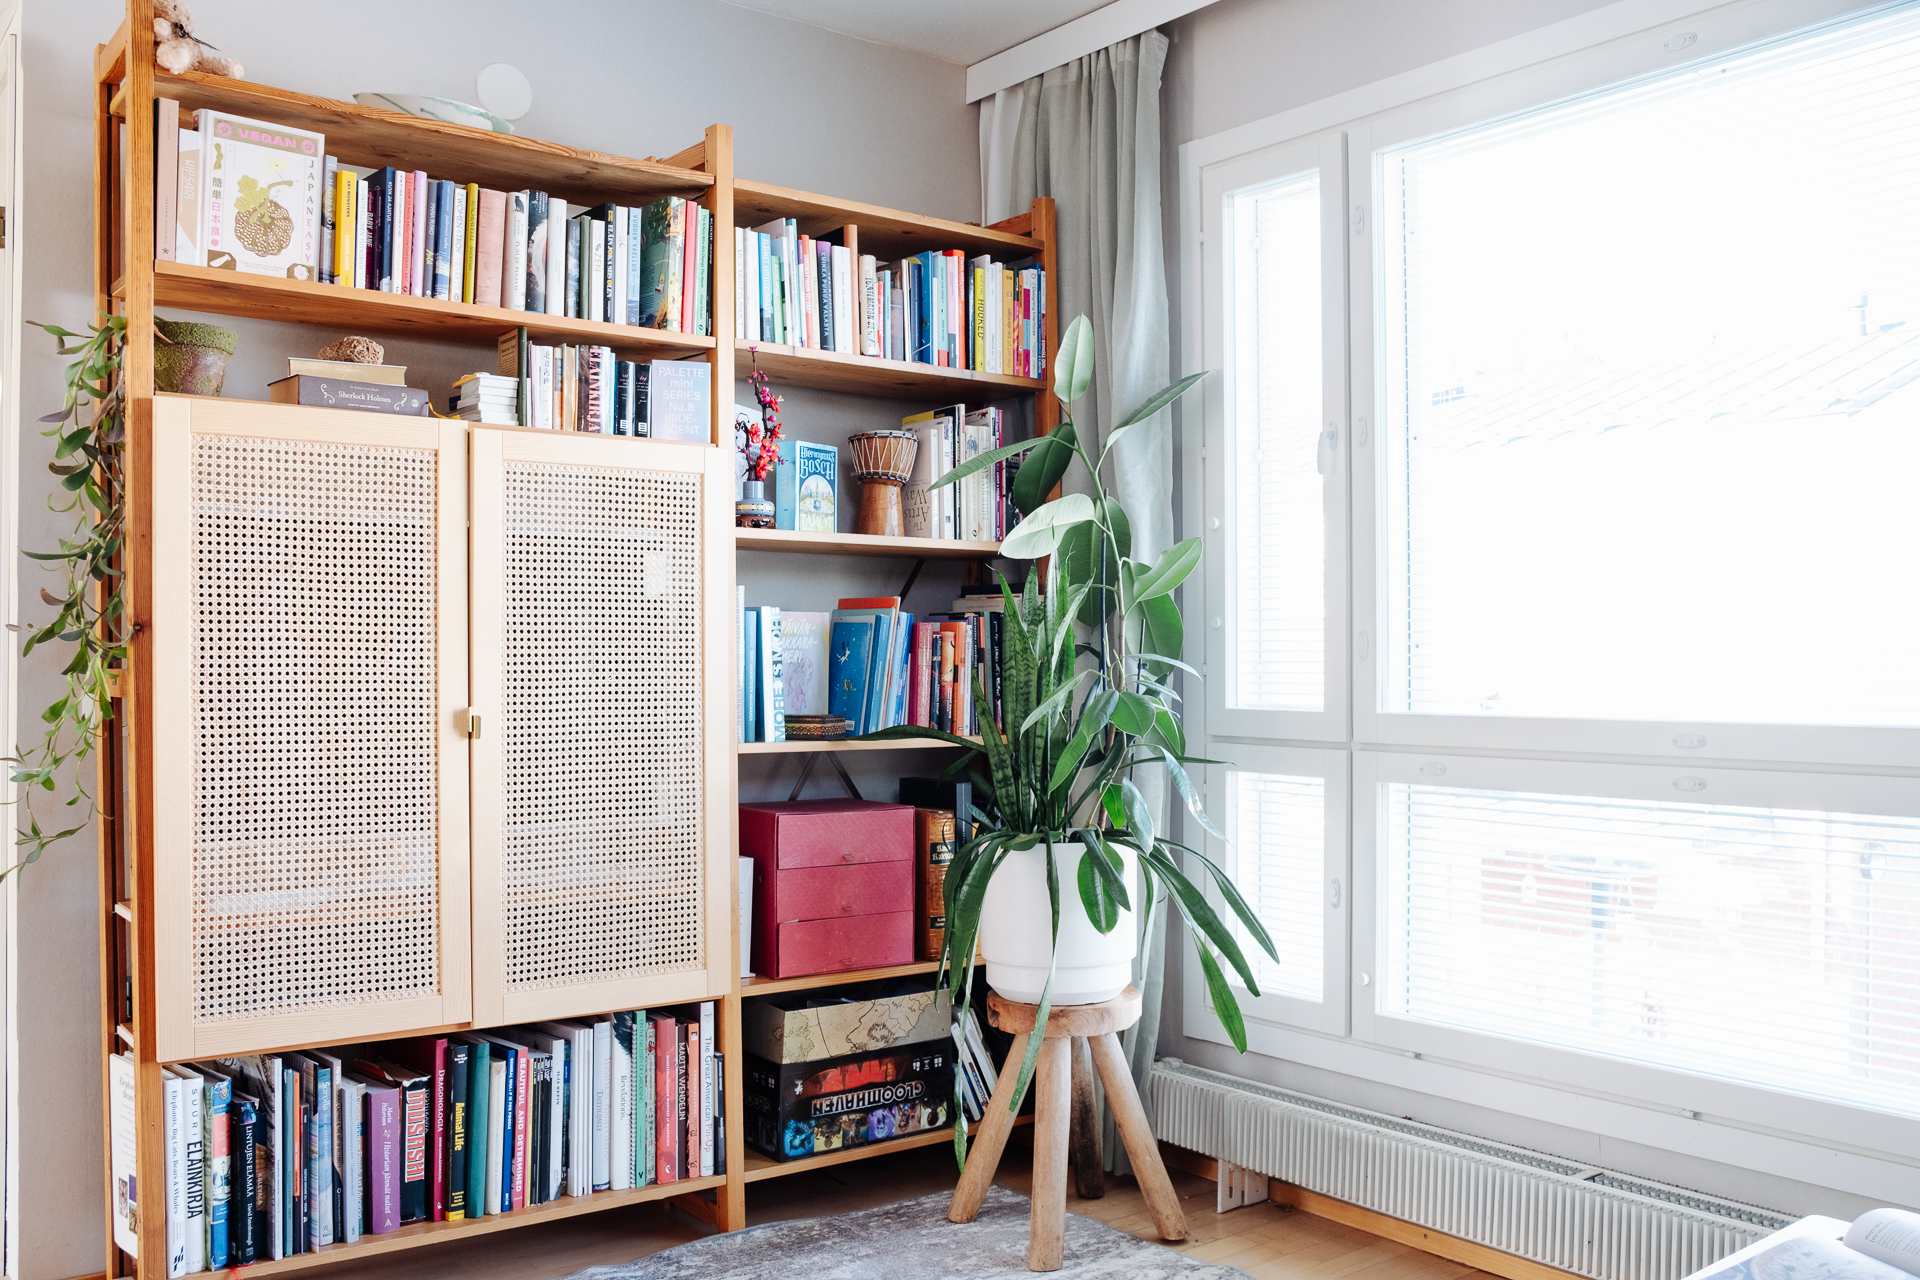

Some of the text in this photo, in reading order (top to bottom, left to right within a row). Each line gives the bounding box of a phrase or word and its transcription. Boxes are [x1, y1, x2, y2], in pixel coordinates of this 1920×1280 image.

[237, 128, 297, 150] VEGAN
[184, 159, 196, 200] KIPSARI
[211, 177, 223, 238] 簡単日本食
[326, 172, 336, 239] CHROMATOPIA
[456, 198, 464, 228] WOMEN
[358, 194, 367, 270] TAITEELLINEN TUTKIMUS
[607, 224, 615, 245] ELÄIN
[594, 252, 602, 273] ZEN
[606, 245, 614, 265] JOKA
[820, 252, 828, 278] KUINKA
[605, 279, 613, 298] OLEN
[762, 238, 772, 318] ELÄIMET YHTEISKUNNASSA
[822, 304, 831, 337] VALASTA
[864, 277, 876, 348] TUNTEMATON SOTILAS
[977, 298, 985, 339] HOOKED
[658, 366, 705, 379] PALETTE
[670, 378, 693, 388] mini
[338, 390, 391, 404] Sherlock Holmes
[662, 389, 701, 401] SERIES
[664, 413, 698, 424] IRIDE-
[799, 458, 835, 480] BOSCH
[800, 446, 835, 463] Hieronymus
[902, 488, 928, 505] Way
[800, 513, 834, 530] TAROT
[903, 506, 931, 523] Artis
[912, 520, 924, 532] The
[773, 687, 786, 743] MORE
[639, 1019, 645, 1030] ON
[321, 1081, 330, 1111] Sorolla
[678, 1042, 686, 1121] MARTTA WENDELIN
[702, 1036, 713, 1153] The Great American Pin-Up
[170, 1089, 180, 1128] Elephants,
[437, 1069, 446, 1132] DRAGONOLOGIA
[595, 1089, 604, 1133] TAITEILIJALLE
[603, 1057, 612, 1162] IHMISEN ANATOMIAA
[619, 1074, 629, 1121] Revelations.
[811, 1079, 926, 1119] GLOOMHAVEN
[454, 1102, 466, 1132] Animal
[515, 1057, 527, 1192] BEAUTIFUL AND DETERMINED
[171, 1128, 180, 1141] Big
[171, 1141, 180, 1158] Cats,
[322, 1124, 330, 1162] MASTERWORKS
[405, 1088, 426, 1183] MUSASHI
[454, 1132, 465, 1152] Life
[186, 1088, 205, 1219] SUURI ELÄINKIRJA
[245, 1125, 255, 1198] LINTUJEN ELÄMÄÄ
[171, 1159, 181, 1180] Bears
[381, 1141, 392, 1214] Historian jännät naiset
[172, 1186, 181, 1215] Whales
[256, 1172, 264, 1206] KALEVALA
[245, 1202, 254, 1246] David Attenborough
